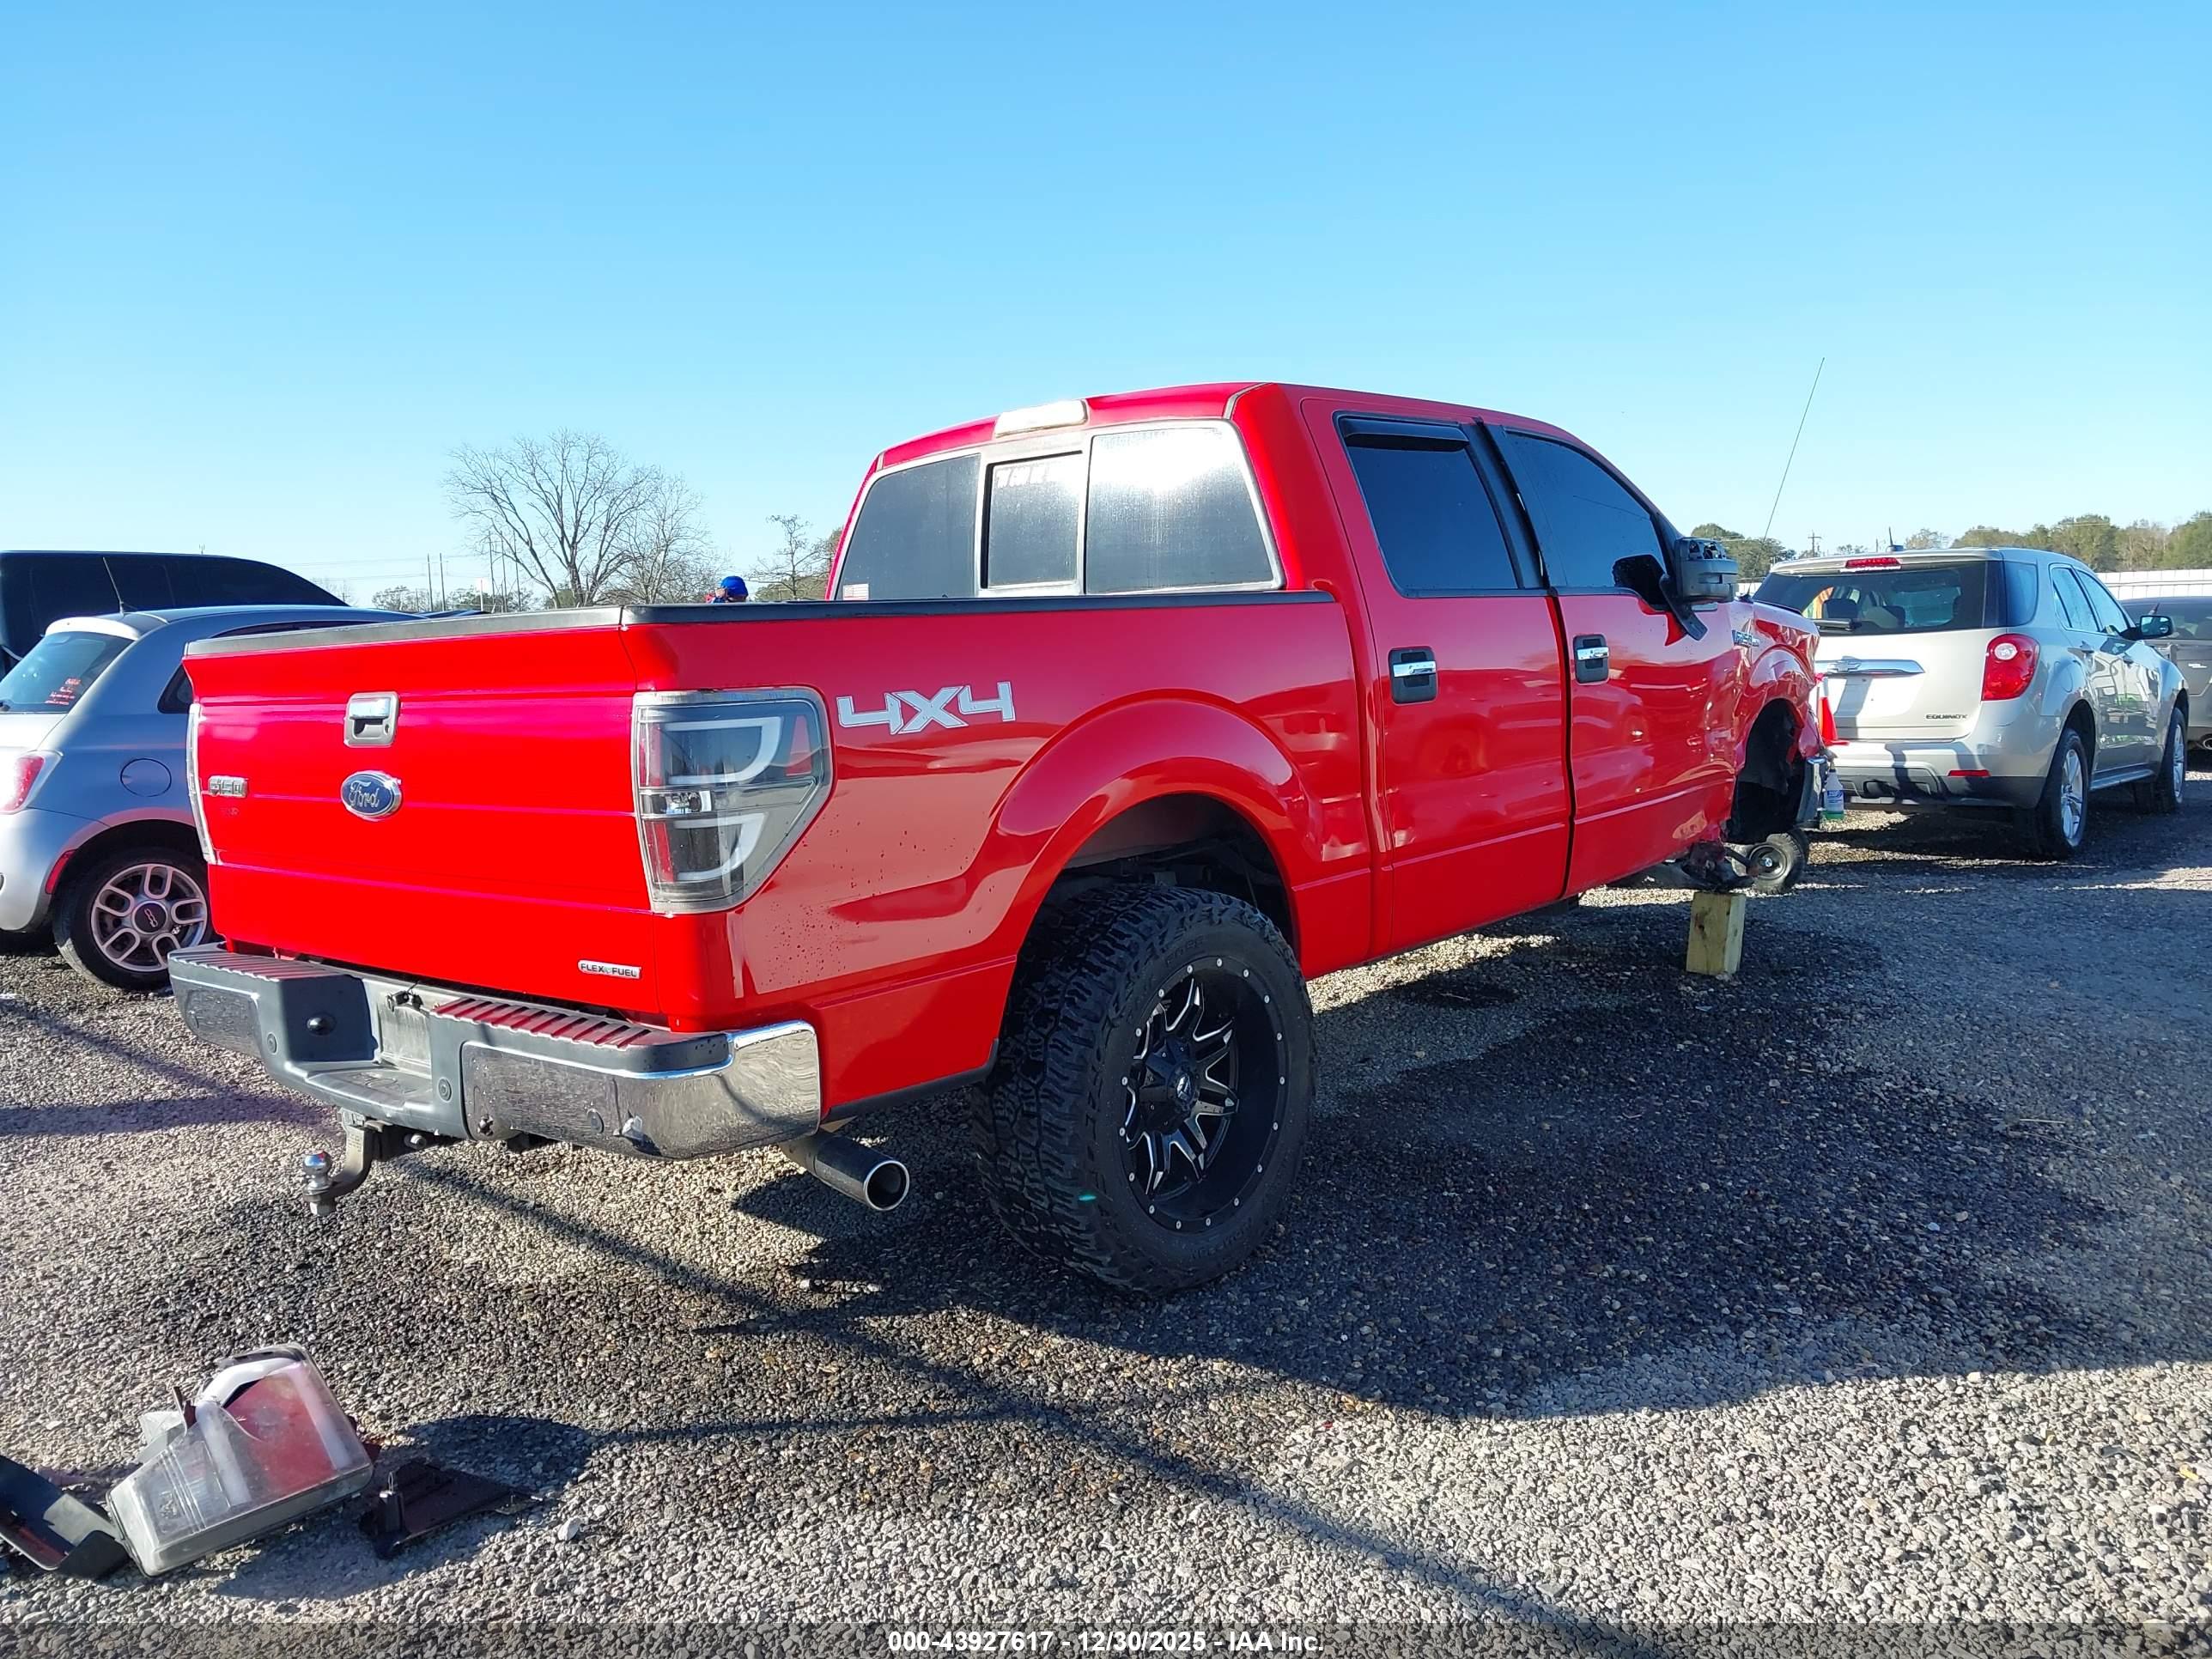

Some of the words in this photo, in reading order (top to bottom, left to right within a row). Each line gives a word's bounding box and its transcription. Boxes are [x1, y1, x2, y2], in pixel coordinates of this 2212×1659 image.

[836, 682, 1016, 735] 4X4
[349, 780, 380, 808] Ford
[580, 963, 605, 973] FLEX
[611, 967, 638, 977] FUEL
